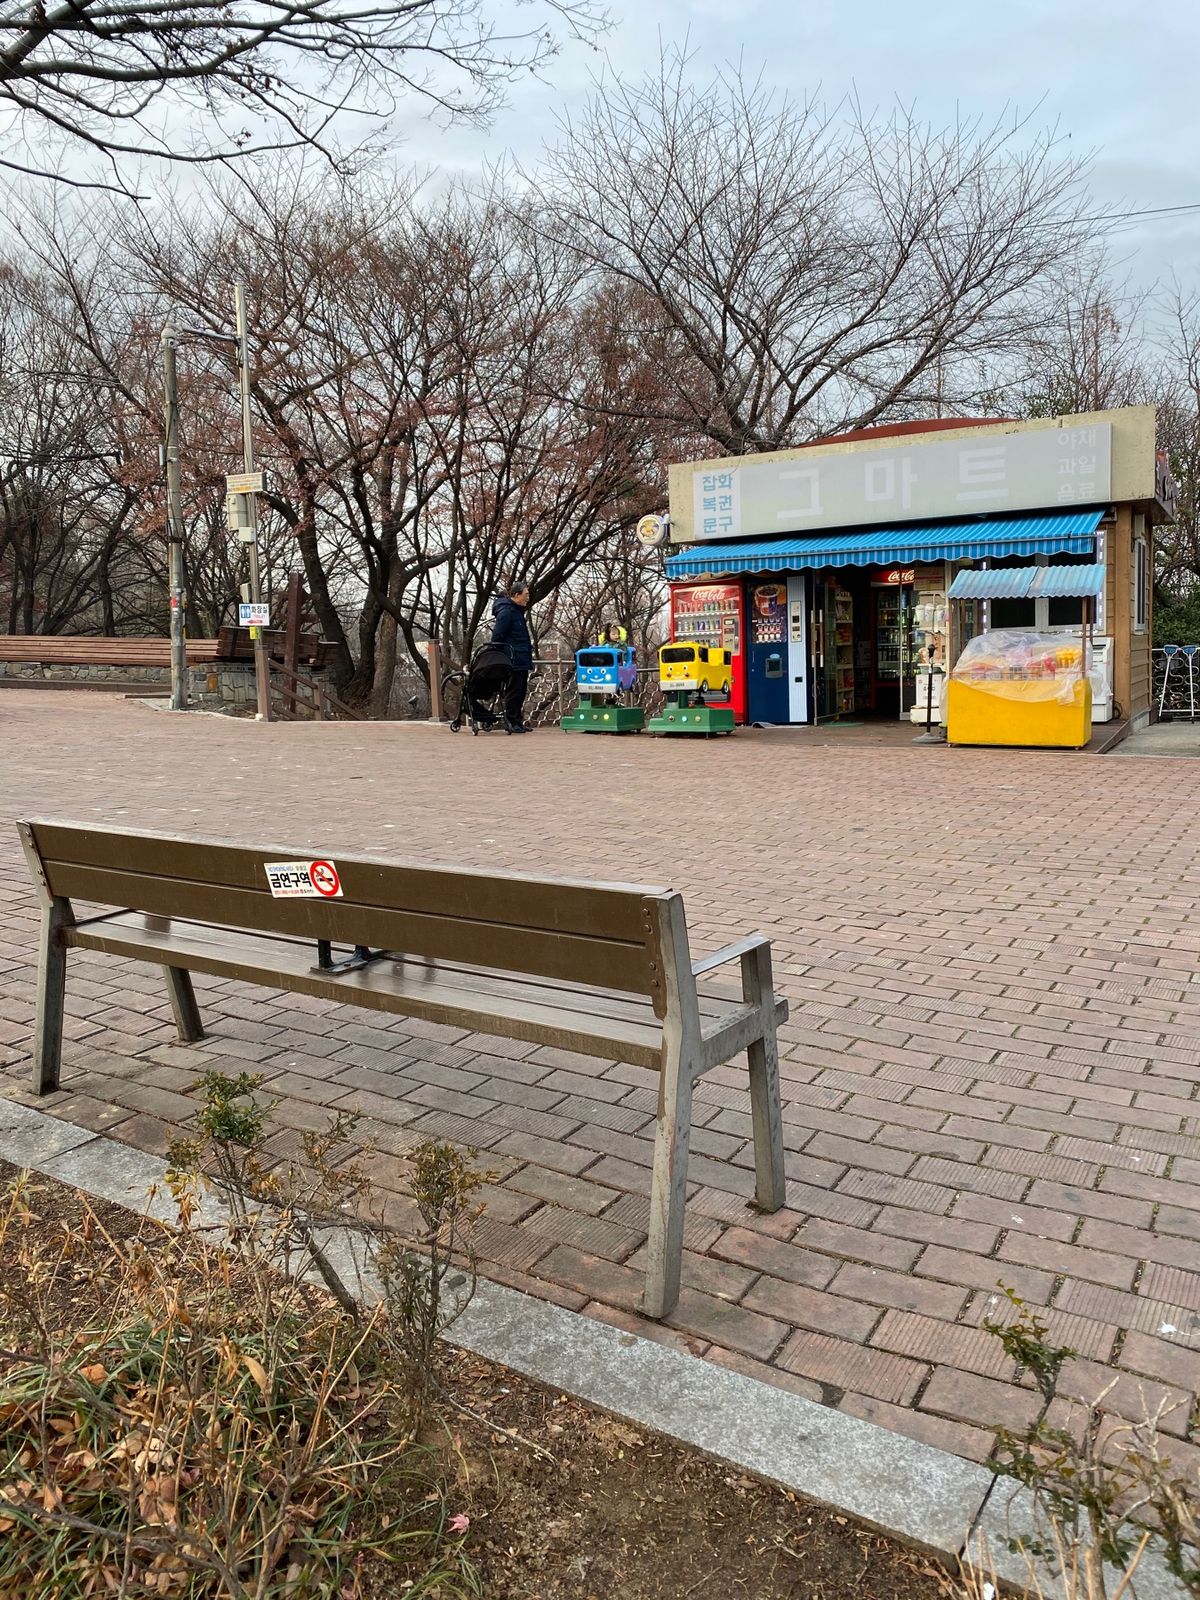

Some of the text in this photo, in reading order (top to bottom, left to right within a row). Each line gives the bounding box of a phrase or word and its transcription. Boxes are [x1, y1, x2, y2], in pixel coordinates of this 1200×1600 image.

[1058, 429, 1096, 450] 야채
[1057, 455, 1096, 475] 과일
[702, 473, 733, 492] 잡화
[1057, 481, 1096, 502] 음료
[703, 494, 733, 512] 복권
[703, 516, 733, 534] 문구
[691, 589, 726, 602] Coca-Cola
[251, 605, 268, 614] 화장실
[269, 872, 313, 889] 금연구역
